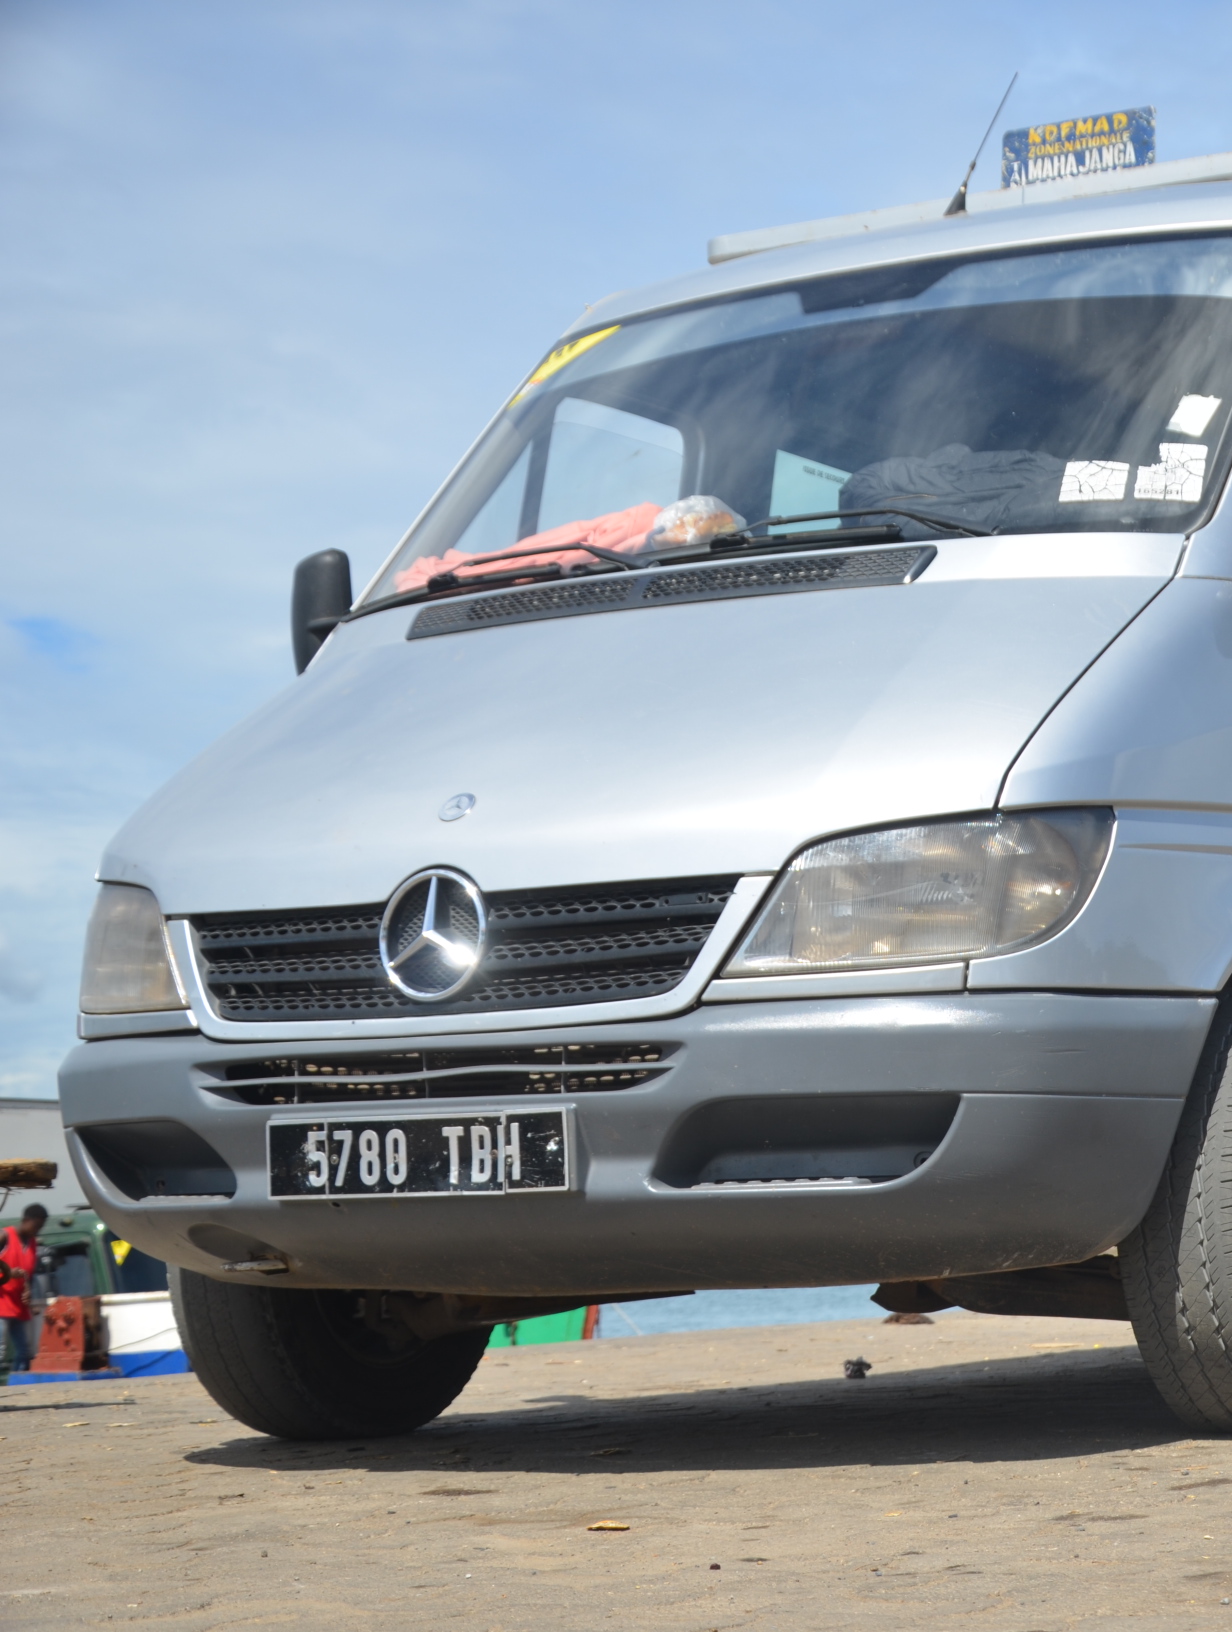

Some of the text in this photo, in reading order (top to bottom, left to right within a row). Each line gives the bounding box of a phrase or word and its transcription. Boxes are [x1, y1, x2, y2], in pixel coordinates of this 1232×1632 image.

[1028, 130, 1130, 158] ZONE NATIONALE
[307, 1122, 521, 1188] 5780 TBH
